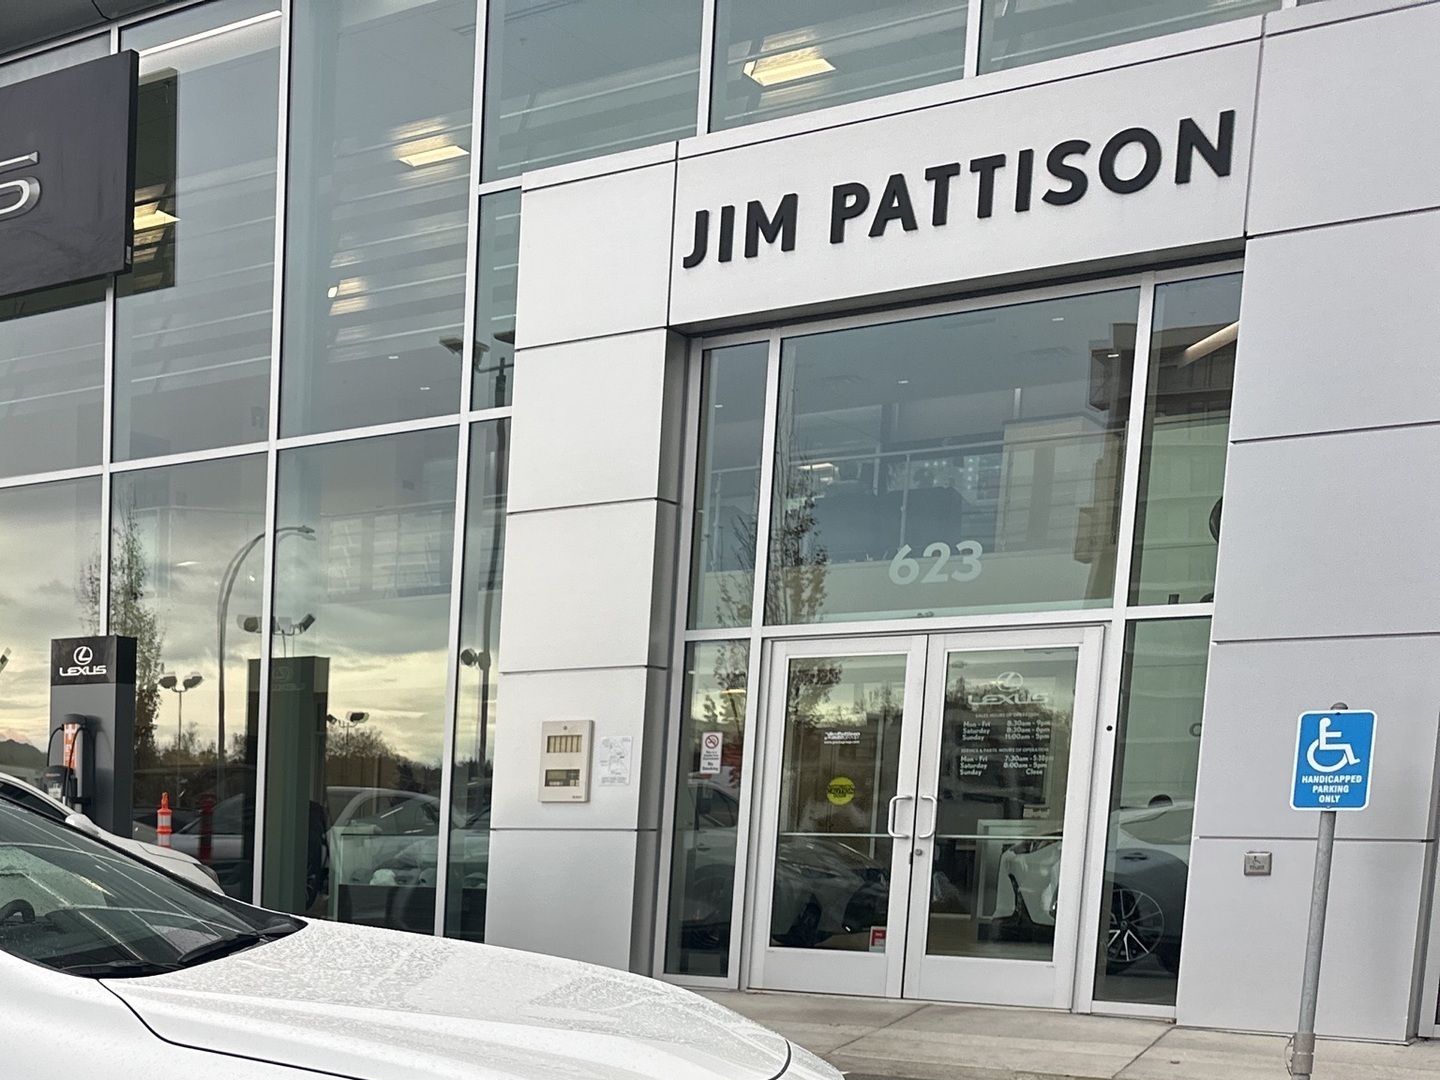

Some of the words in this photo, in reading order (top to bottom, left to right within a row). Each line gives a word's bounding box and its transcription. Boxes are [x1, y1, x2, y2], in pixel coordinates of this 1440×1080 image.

[683, 193, 798, 269] JIM
[830, 109, 1235, 244] PATTISON
[888, 540, 983, 585] 623
[59, 665, 107, 677] LEXUS
[968, 693, 1049, 705] LEXUS
[962, 727, 990, 735] Saturday
[960, 762, 987, 770] Saturday
[1301, 775, 1362, 783] HANDICAPPED
[1312, 785, 1349, 793] PARKING
[1318, 795, 1340, 803] ONLY
